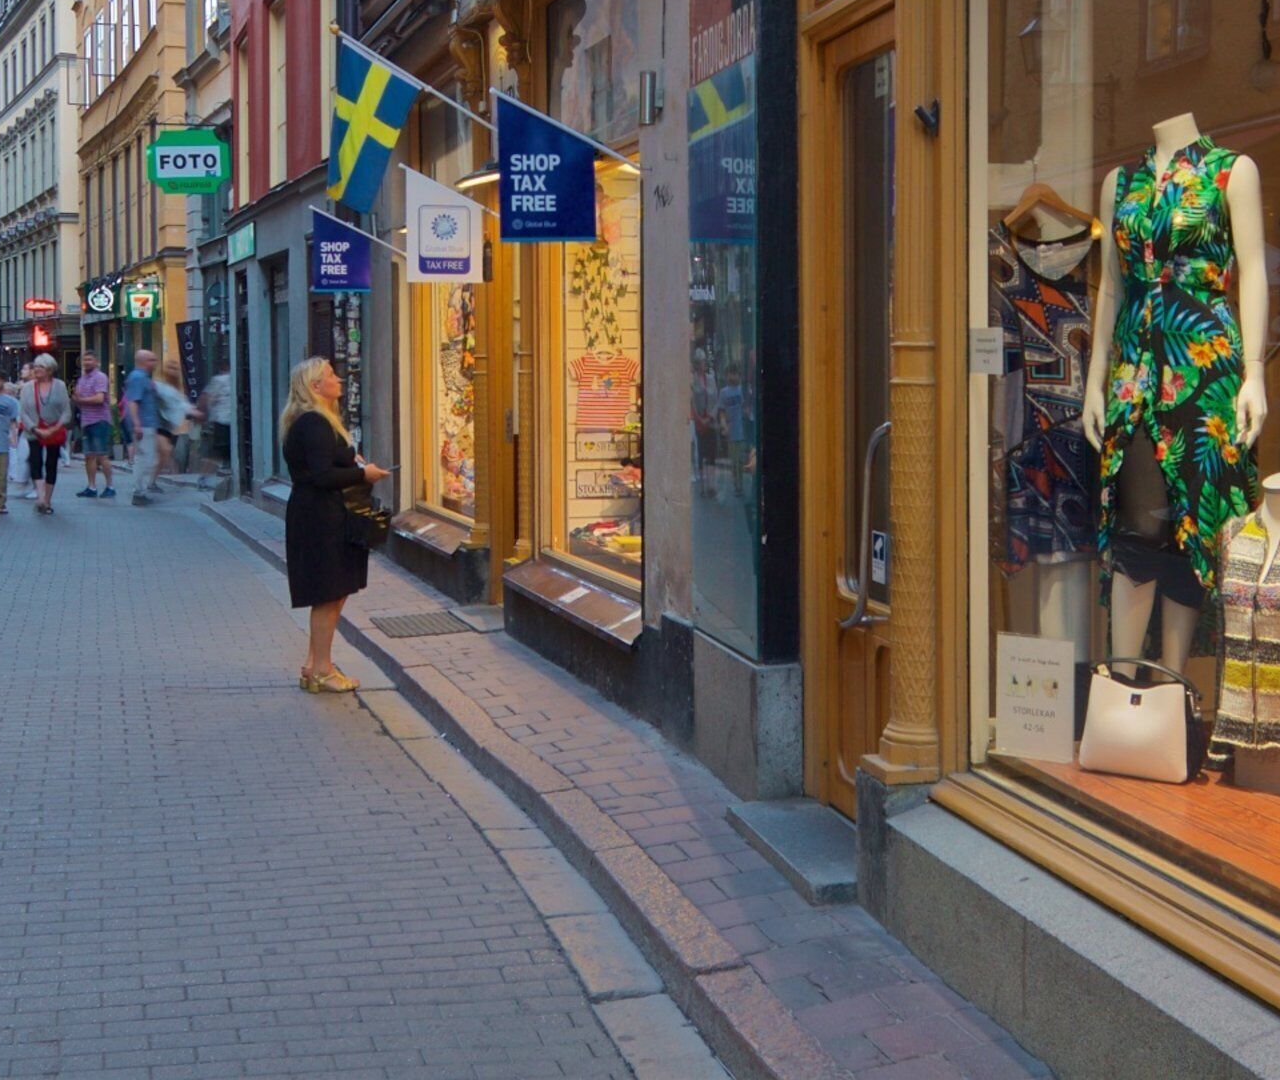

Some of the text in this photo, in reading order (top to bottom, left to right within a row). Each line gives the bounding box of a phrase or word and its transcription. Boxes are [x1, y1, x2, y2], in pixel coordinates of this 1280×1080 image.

[159, 153, 217, 170] FOTO
[510, 153, 561, 172] SHOP
[510, 174, 547, 192] TAX
[511, 194, 557, 212] FREE
[524, 221, 543, 229] Global
[320, 241, 350, 253] SHOP
[320, 253, 342, 264] TAX
[320, 265, 348, 276] FREE
[426, 260, 464, 271] TAX FREE
